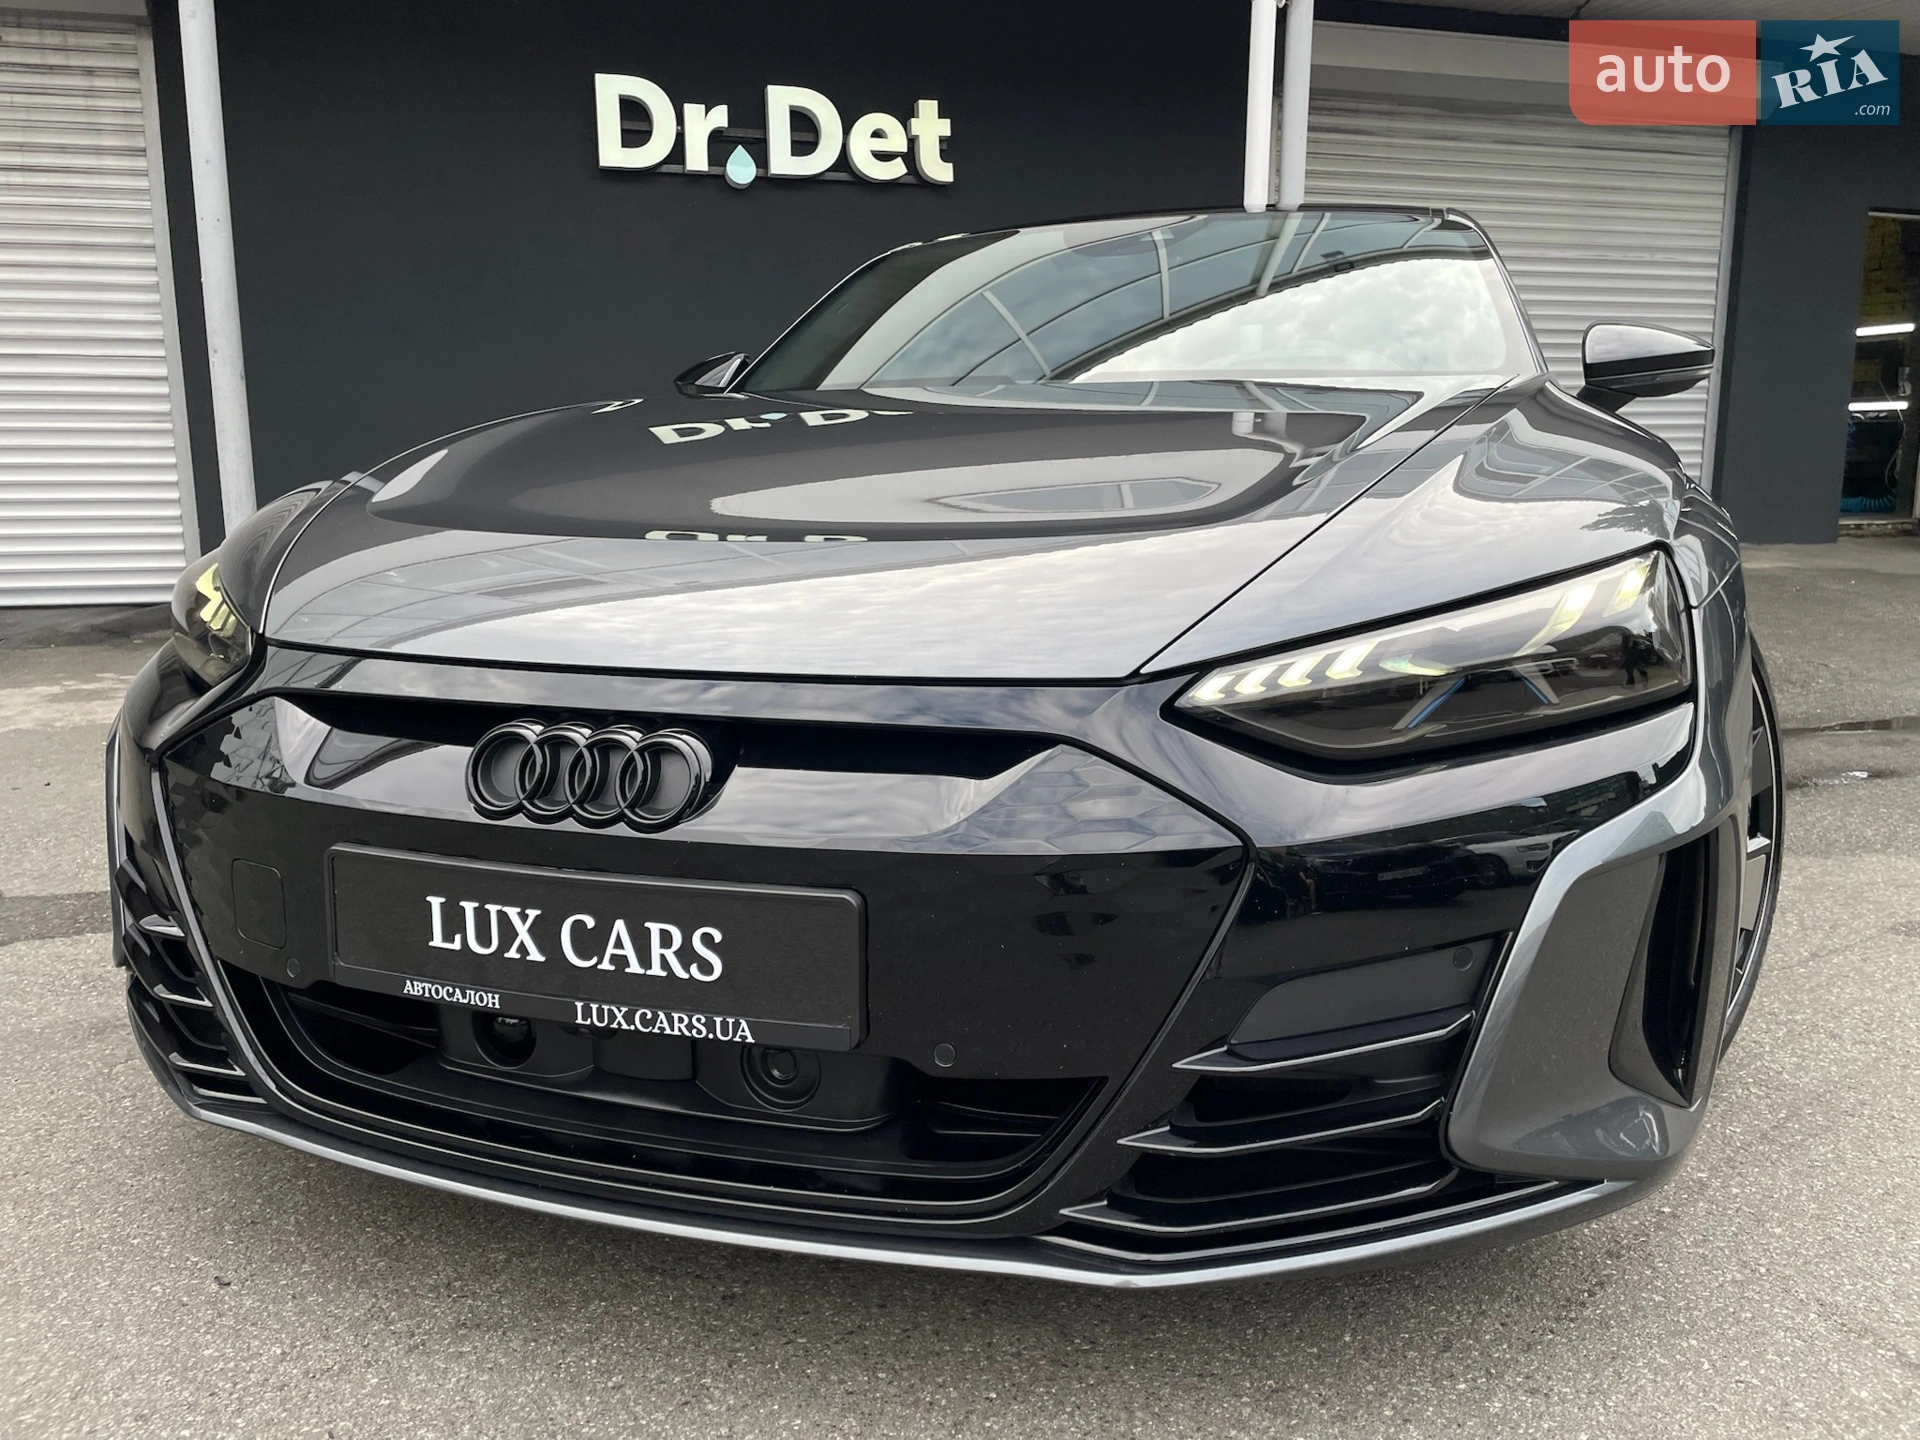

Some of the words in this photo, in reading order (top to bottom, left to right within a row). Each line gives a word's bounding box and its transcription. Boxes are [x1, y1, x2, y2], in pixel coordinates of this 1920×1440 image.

[426, 895, 546, 962] LUX
[560, 913, 724, 983] CARS
[402, 979, 501, 1009] АВТОСАЛОН
[574, 1001, 756, 1044] LUX.CARS.UA
